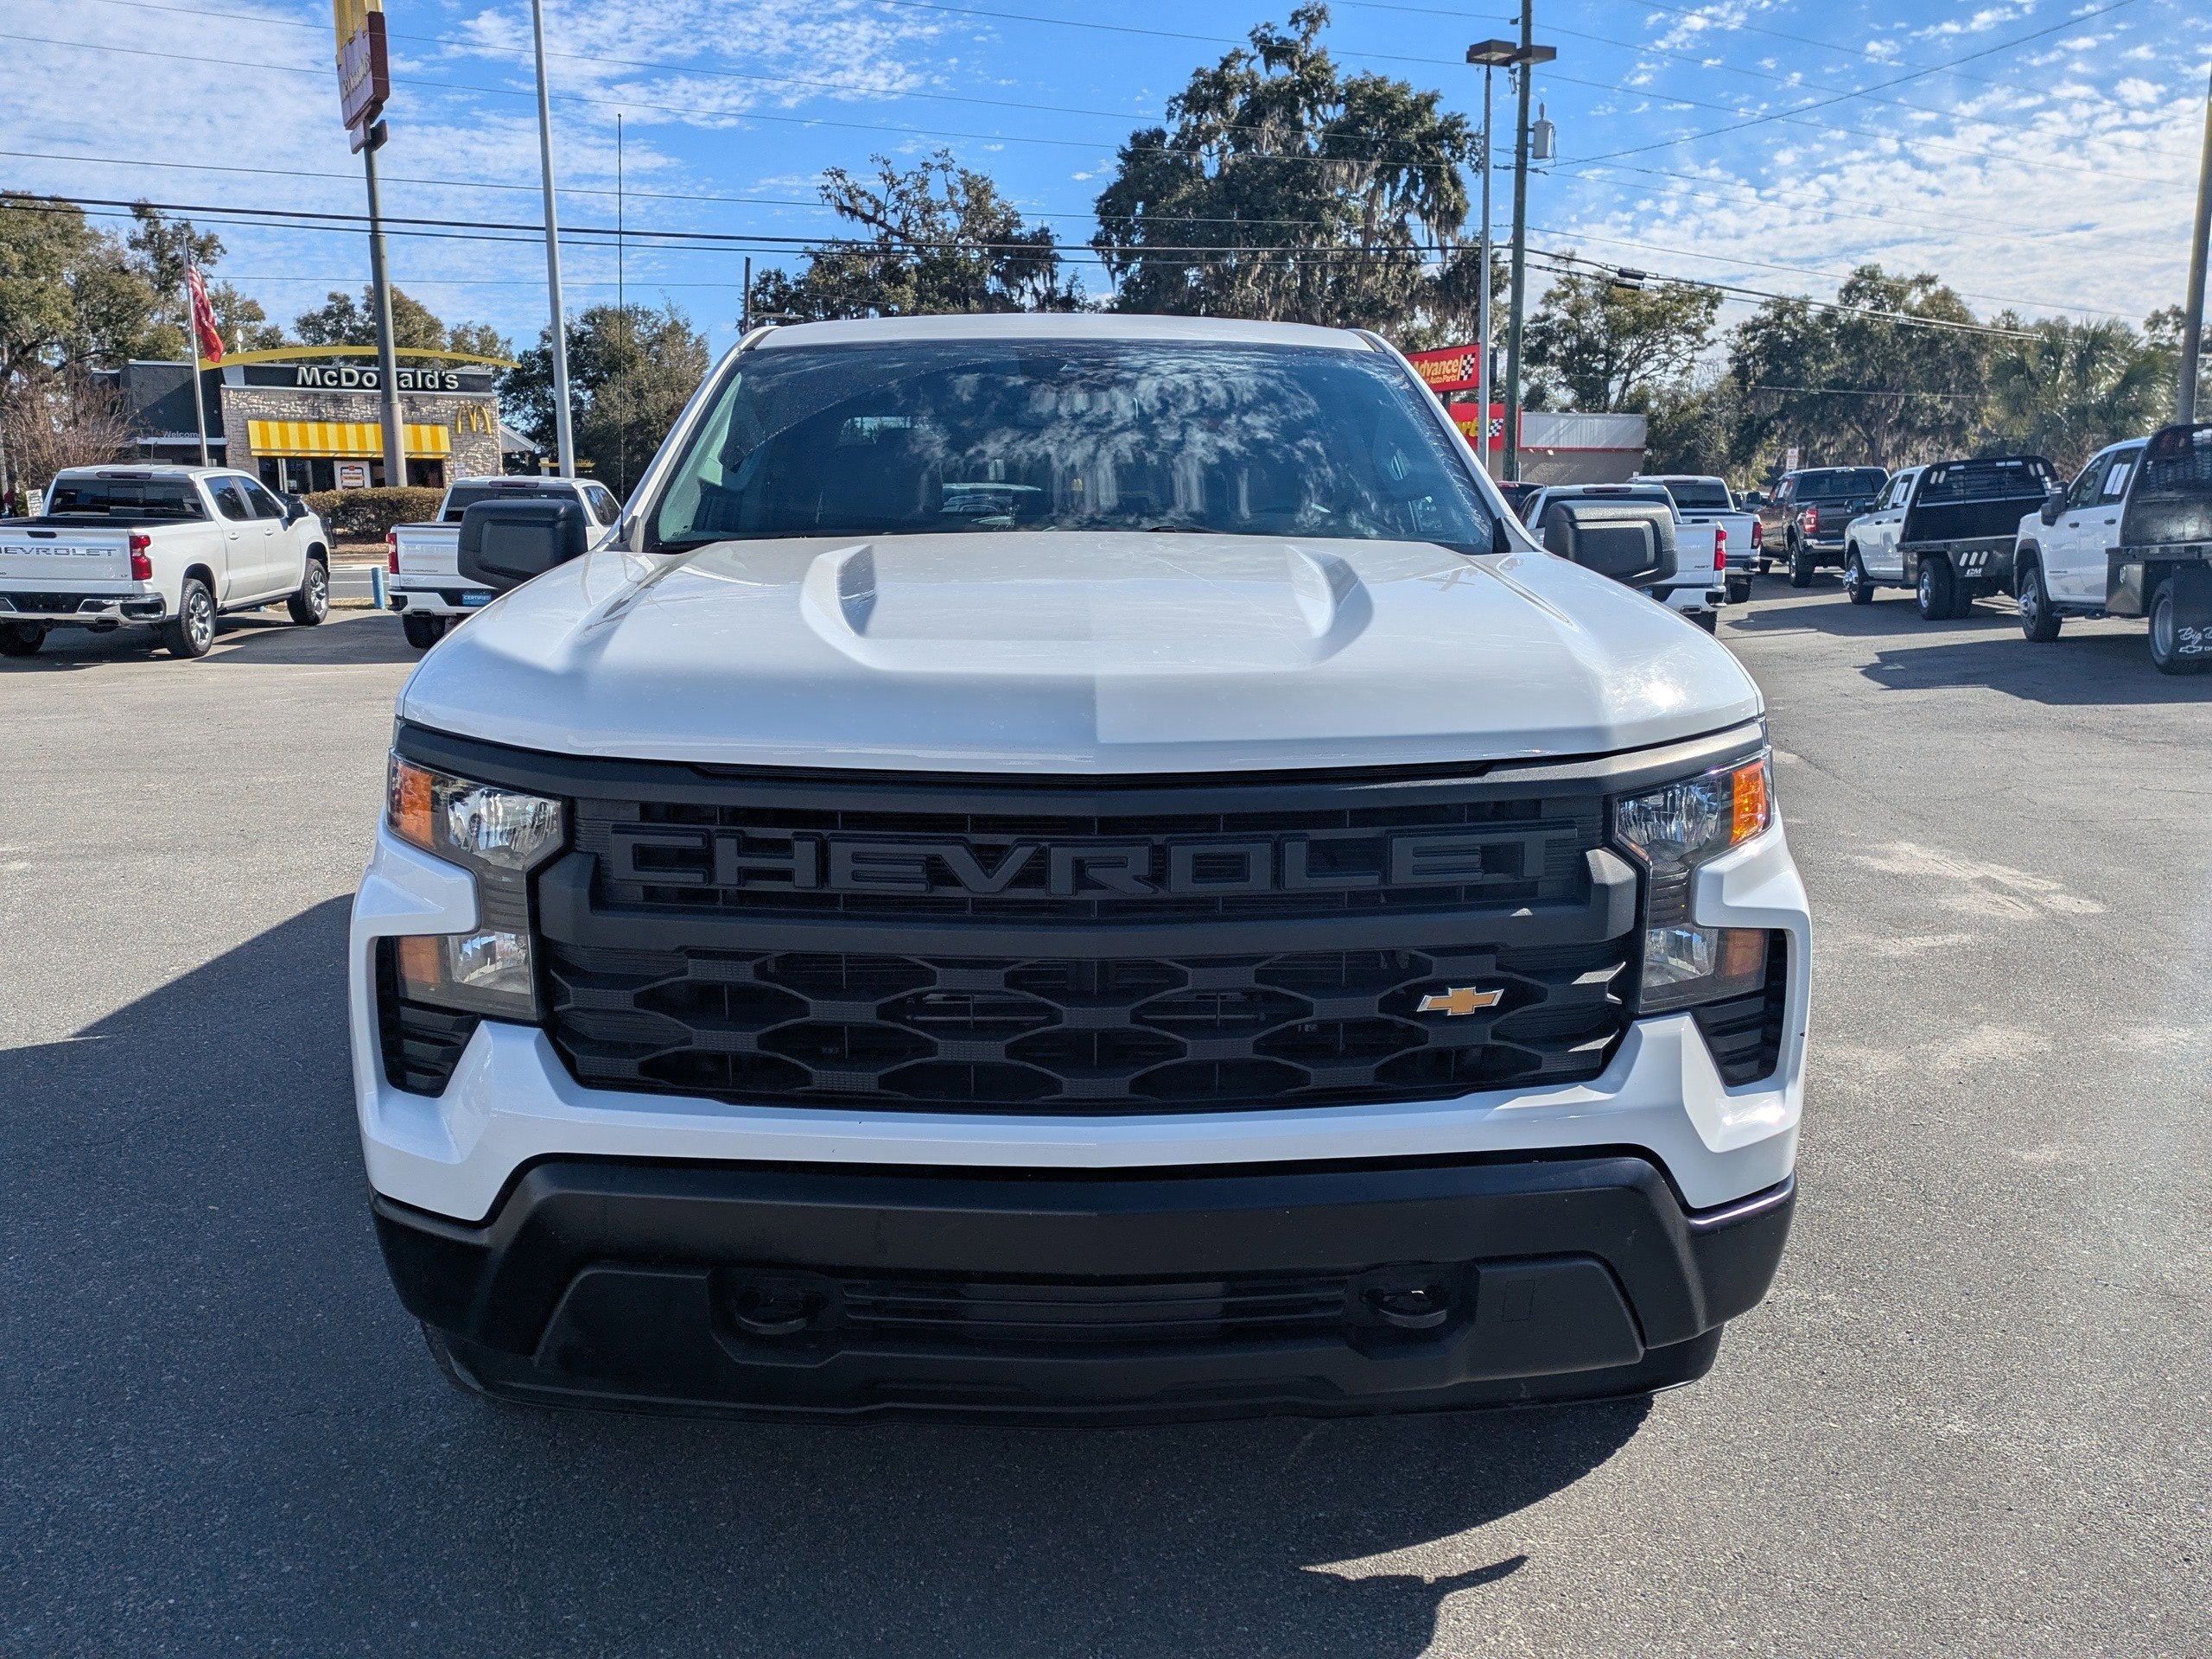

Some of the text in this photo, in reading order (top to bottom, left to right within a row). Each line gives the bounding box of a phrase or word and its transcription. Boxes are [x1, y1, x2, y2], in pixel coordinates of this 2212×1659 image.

[296, 366, 459, 389] McDoald's
[2177, 626, 2202, 645] Big
[611, 822, 1578, 895] CHEVROLET
